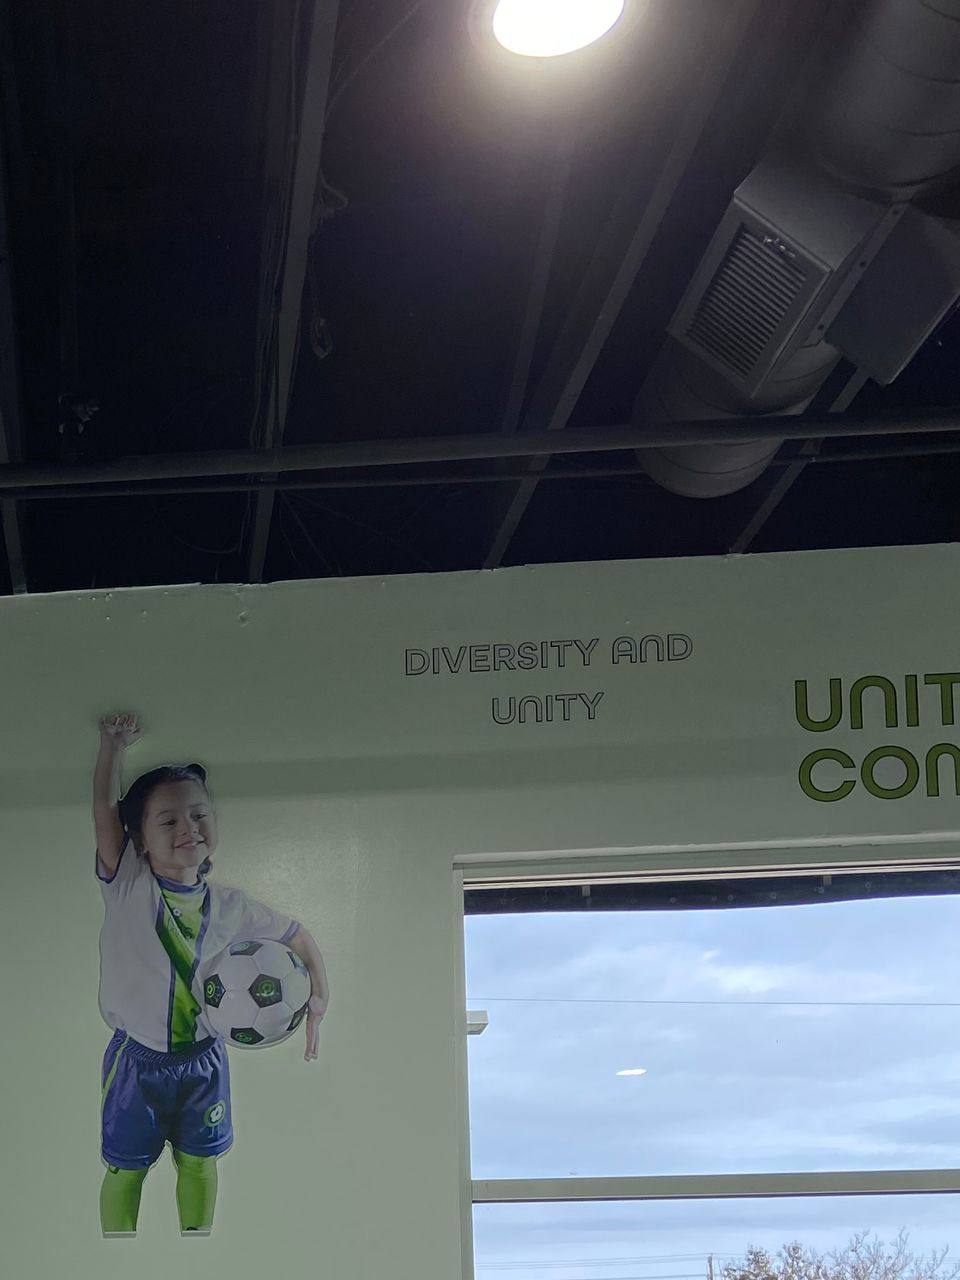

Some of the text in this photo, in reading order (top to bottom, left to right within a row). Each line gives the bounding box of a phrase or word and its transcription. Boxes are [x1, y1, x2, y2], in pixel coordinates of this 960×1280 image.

[404, 632, 693, 676] DIVERSITY AND
[491, 691, 605, 725] UNITY
[794, 672, 960, 732] UNIT
